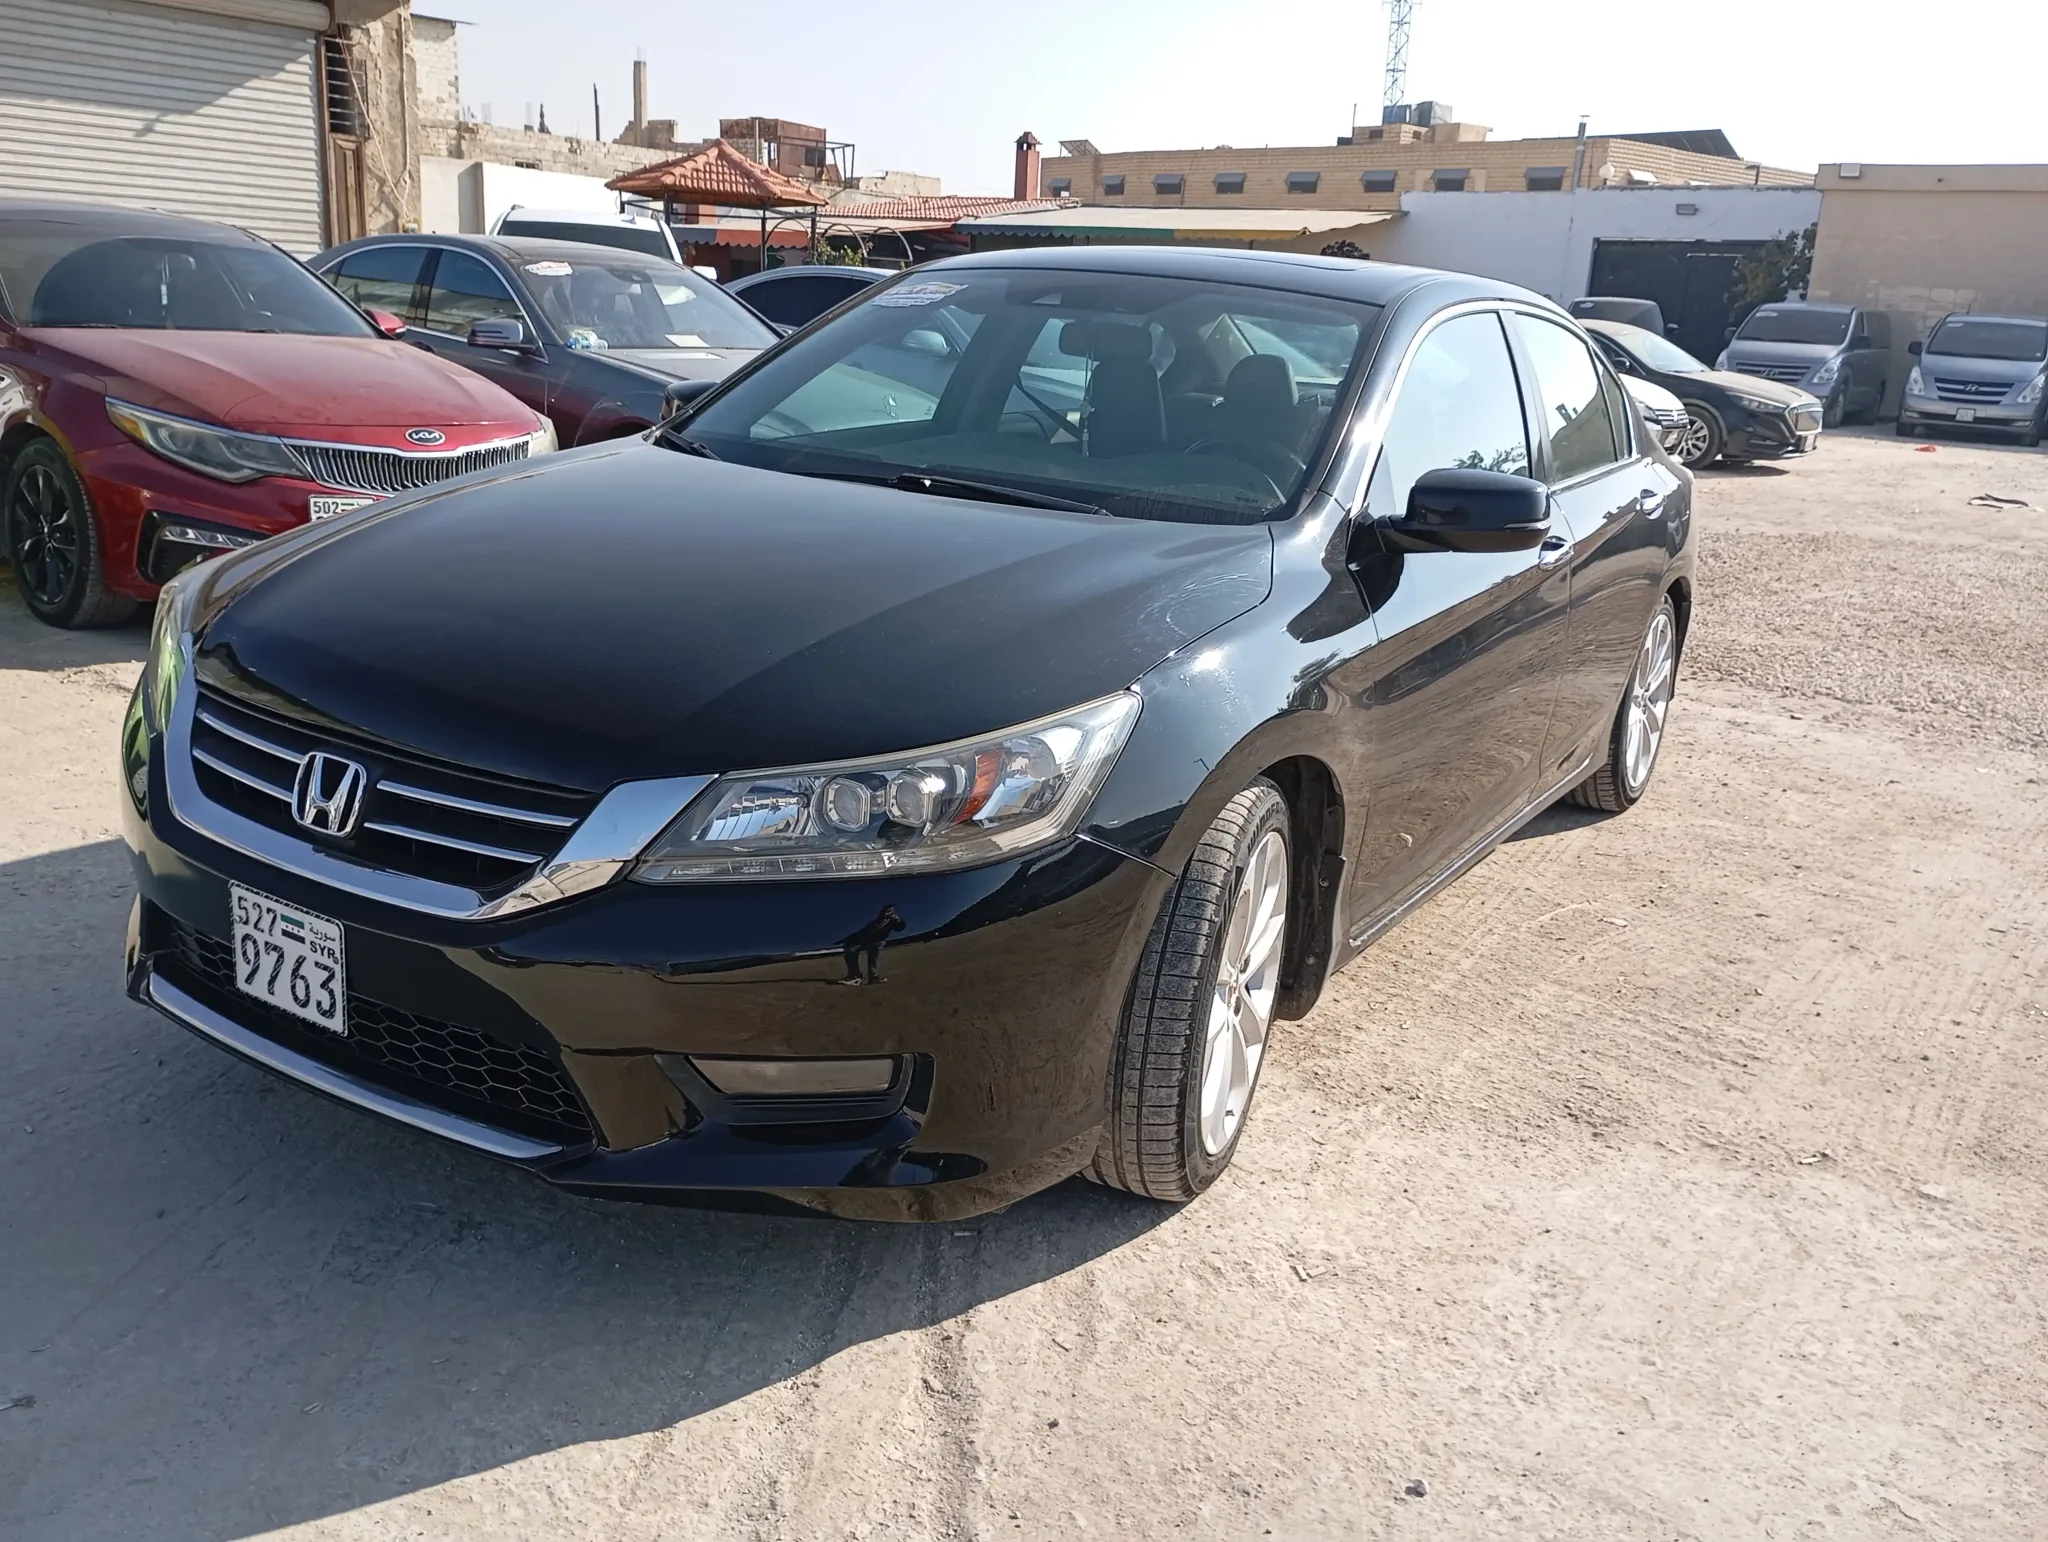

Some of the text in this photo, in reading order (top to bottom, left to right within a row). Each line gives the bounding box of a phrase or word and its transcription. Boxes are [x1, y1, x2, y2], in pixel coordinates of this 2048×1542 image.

[313, 501, 339, 514] 502
[238, 896, 277, 937] 527
[309, 922, 336, 943] سورية
[310, 940, 337, 961] SYR
[241, 933, 337, 1020] 9763
